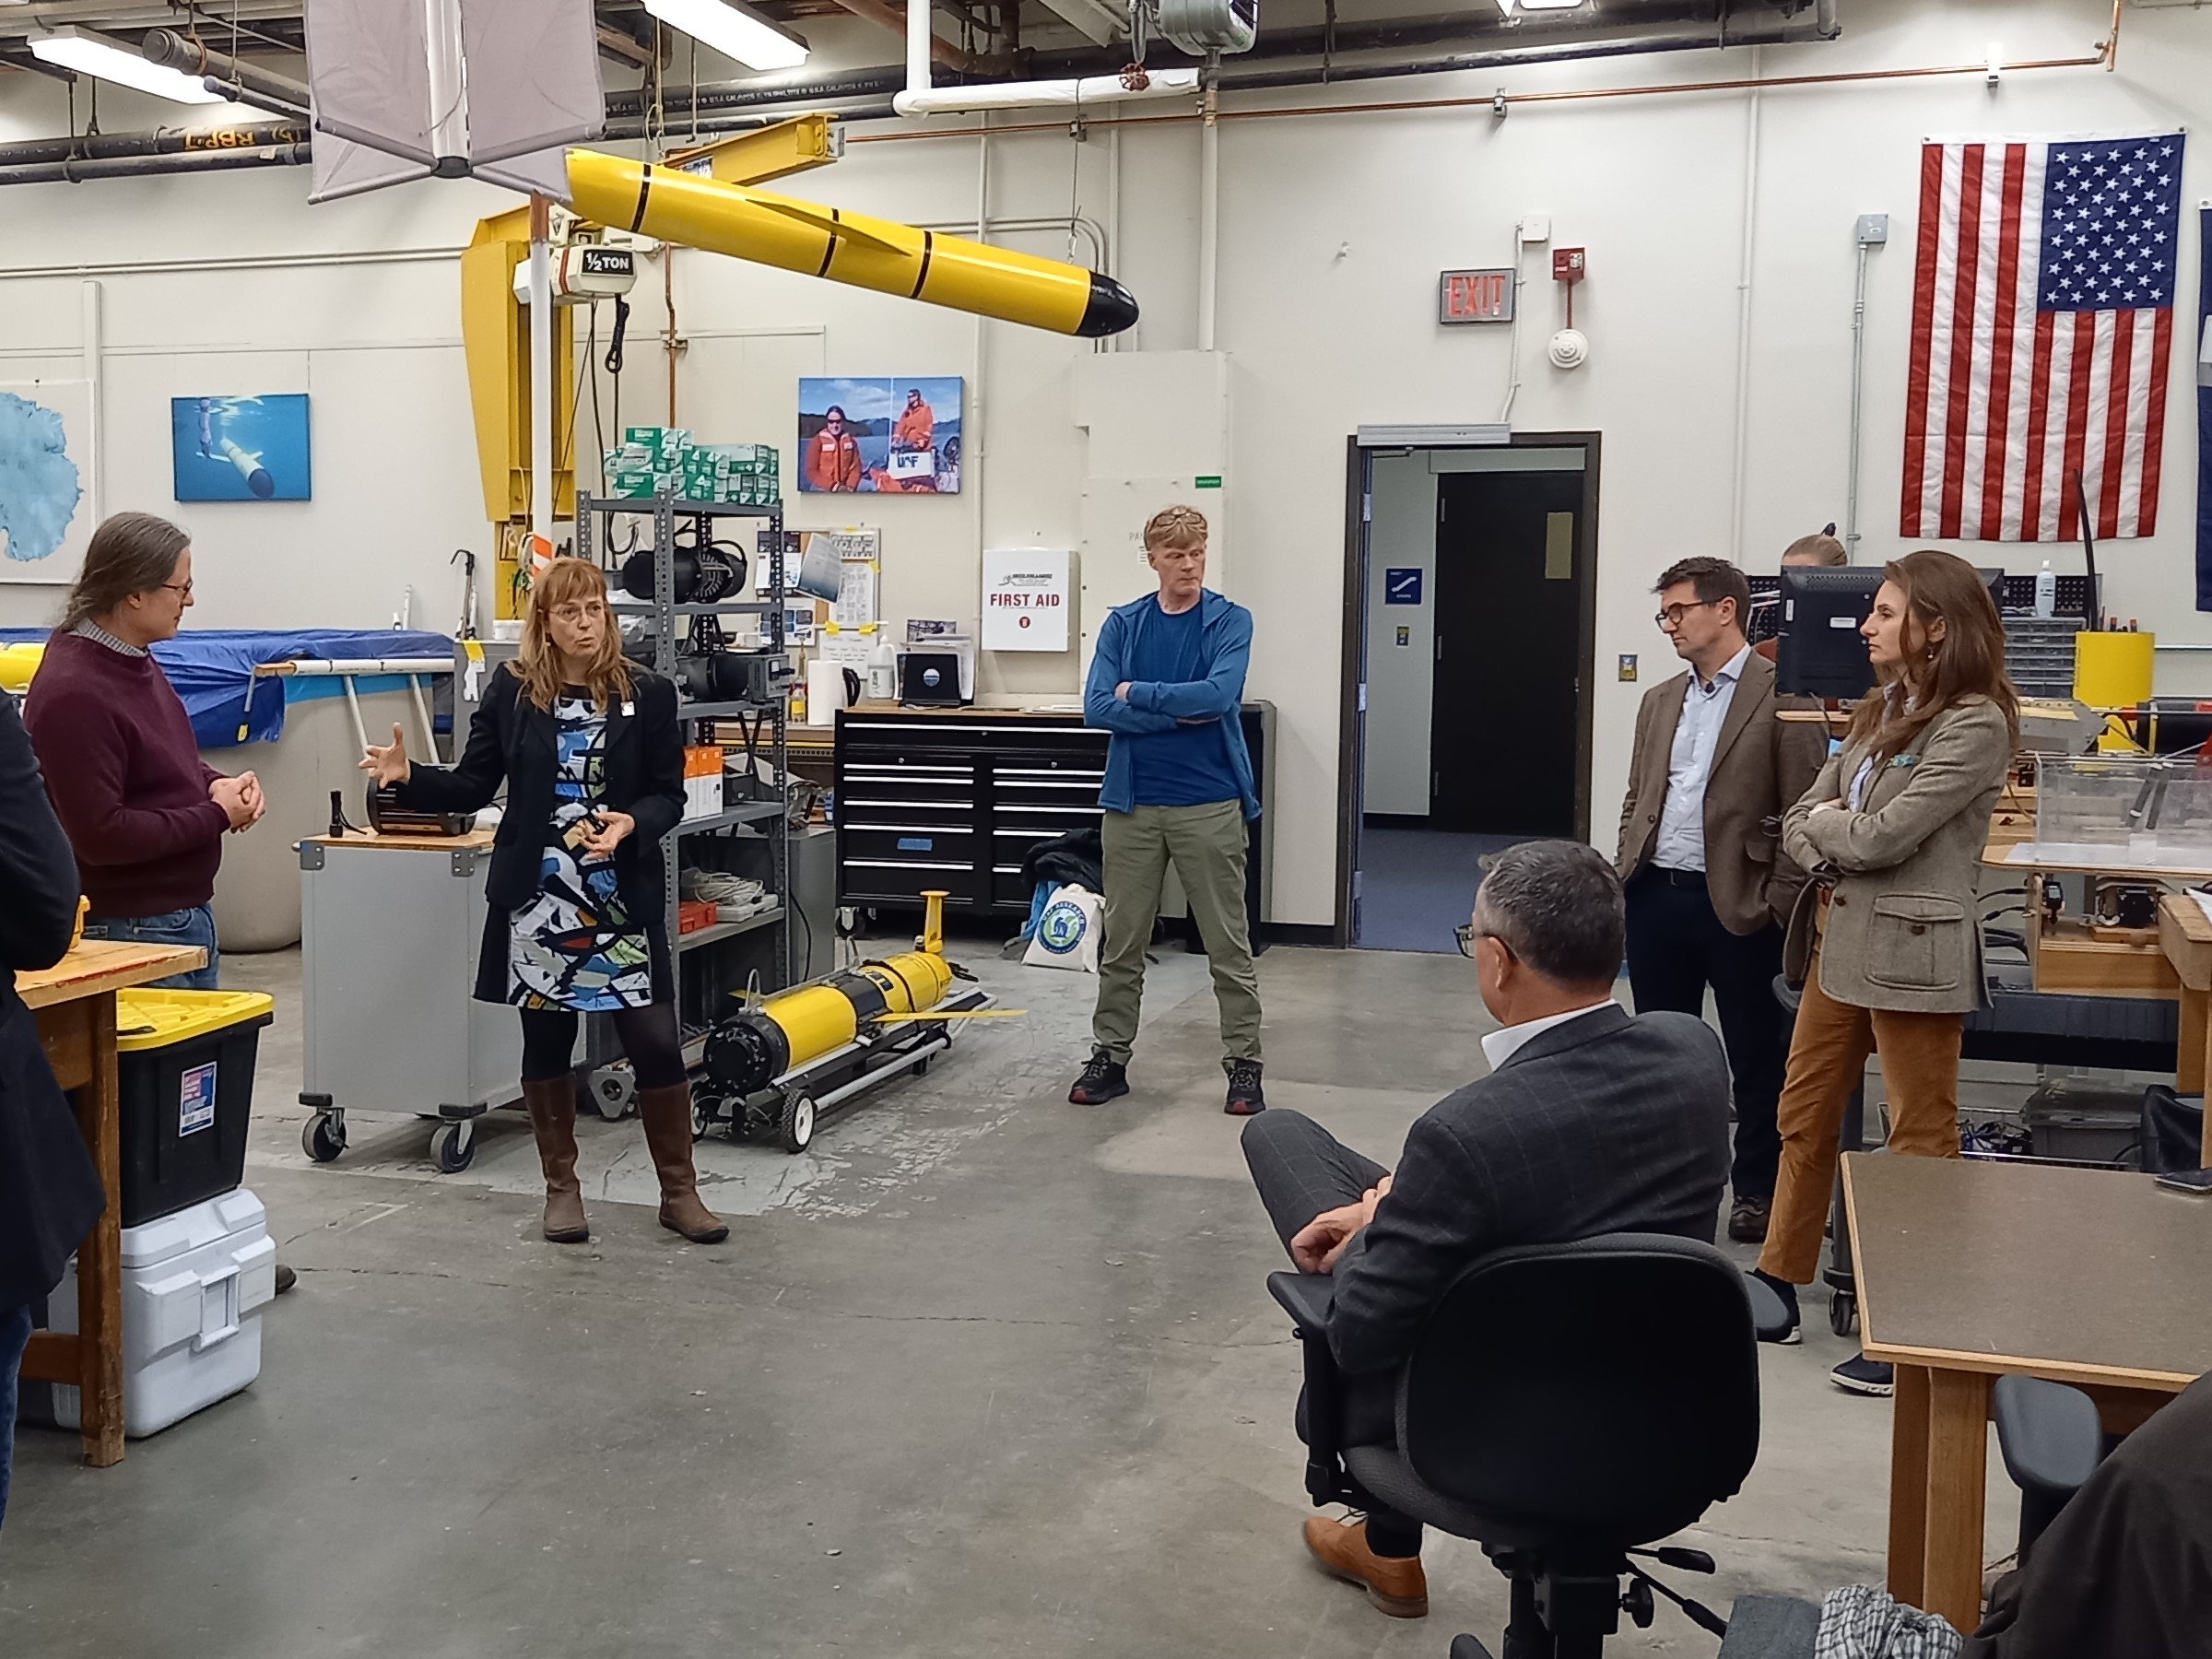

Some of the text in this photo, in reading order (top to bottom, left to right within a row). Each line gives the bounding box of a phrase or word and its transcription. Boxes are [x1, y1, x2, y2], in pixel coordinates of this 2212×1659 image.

[602, 256, 629, 269] TON
[1449, 276, 1505, 315] EXIT
[990, 594, 1060, 607] FIRST AID
